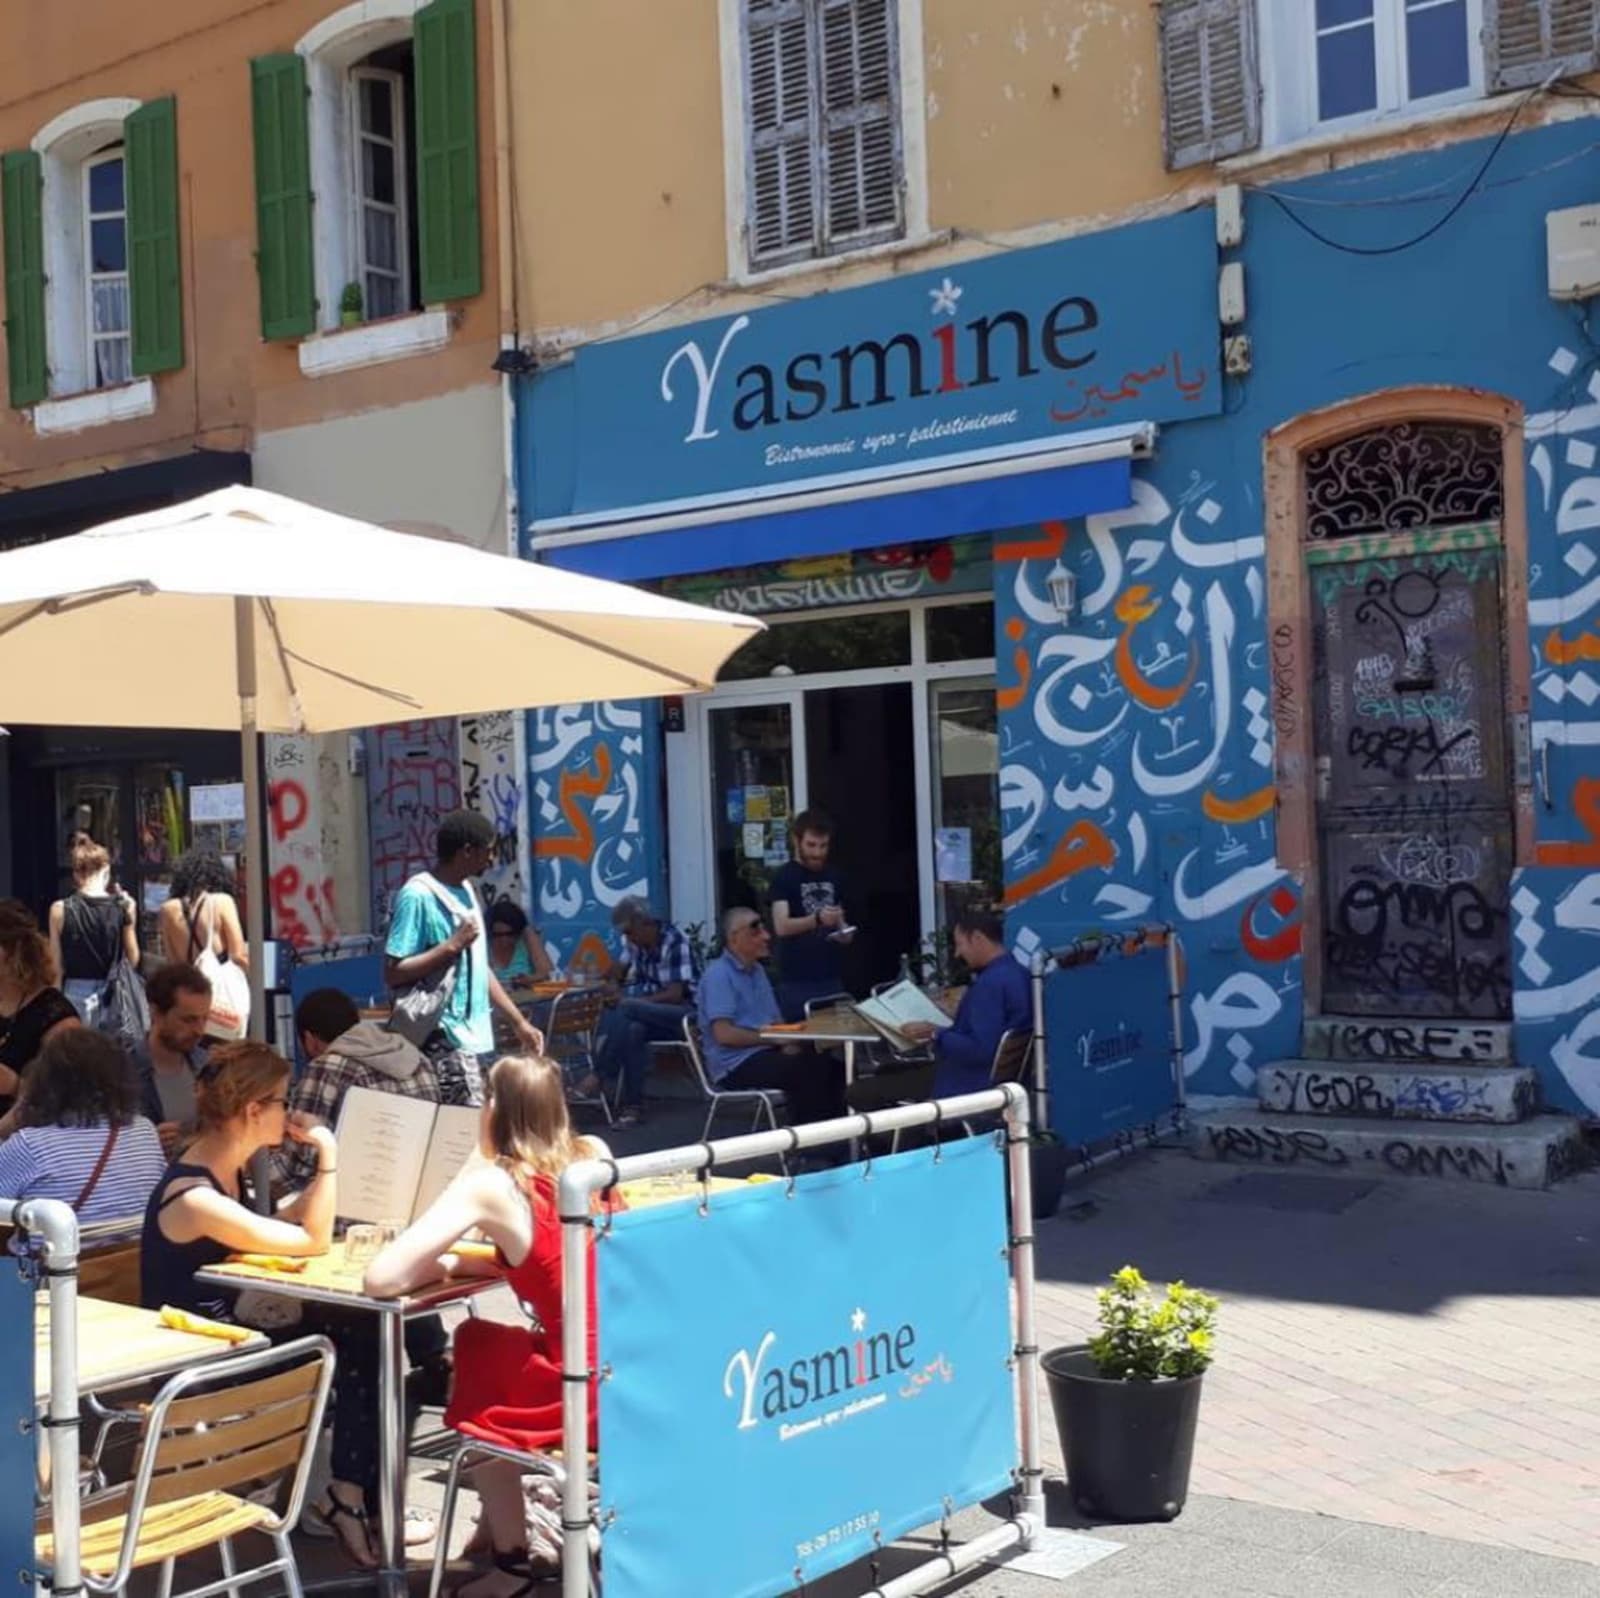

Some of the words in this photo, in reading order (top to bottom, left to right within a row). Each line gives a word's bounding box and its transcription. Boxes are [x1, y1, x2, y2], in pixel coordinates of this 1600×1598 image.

[661, 278, 1098, 443] Yasmine
[1050, 350, 1206, 422] ياسمين
[764, 442, 855, 467] Bistronomie
[723, 1306, 916, 1430] Yasmine
